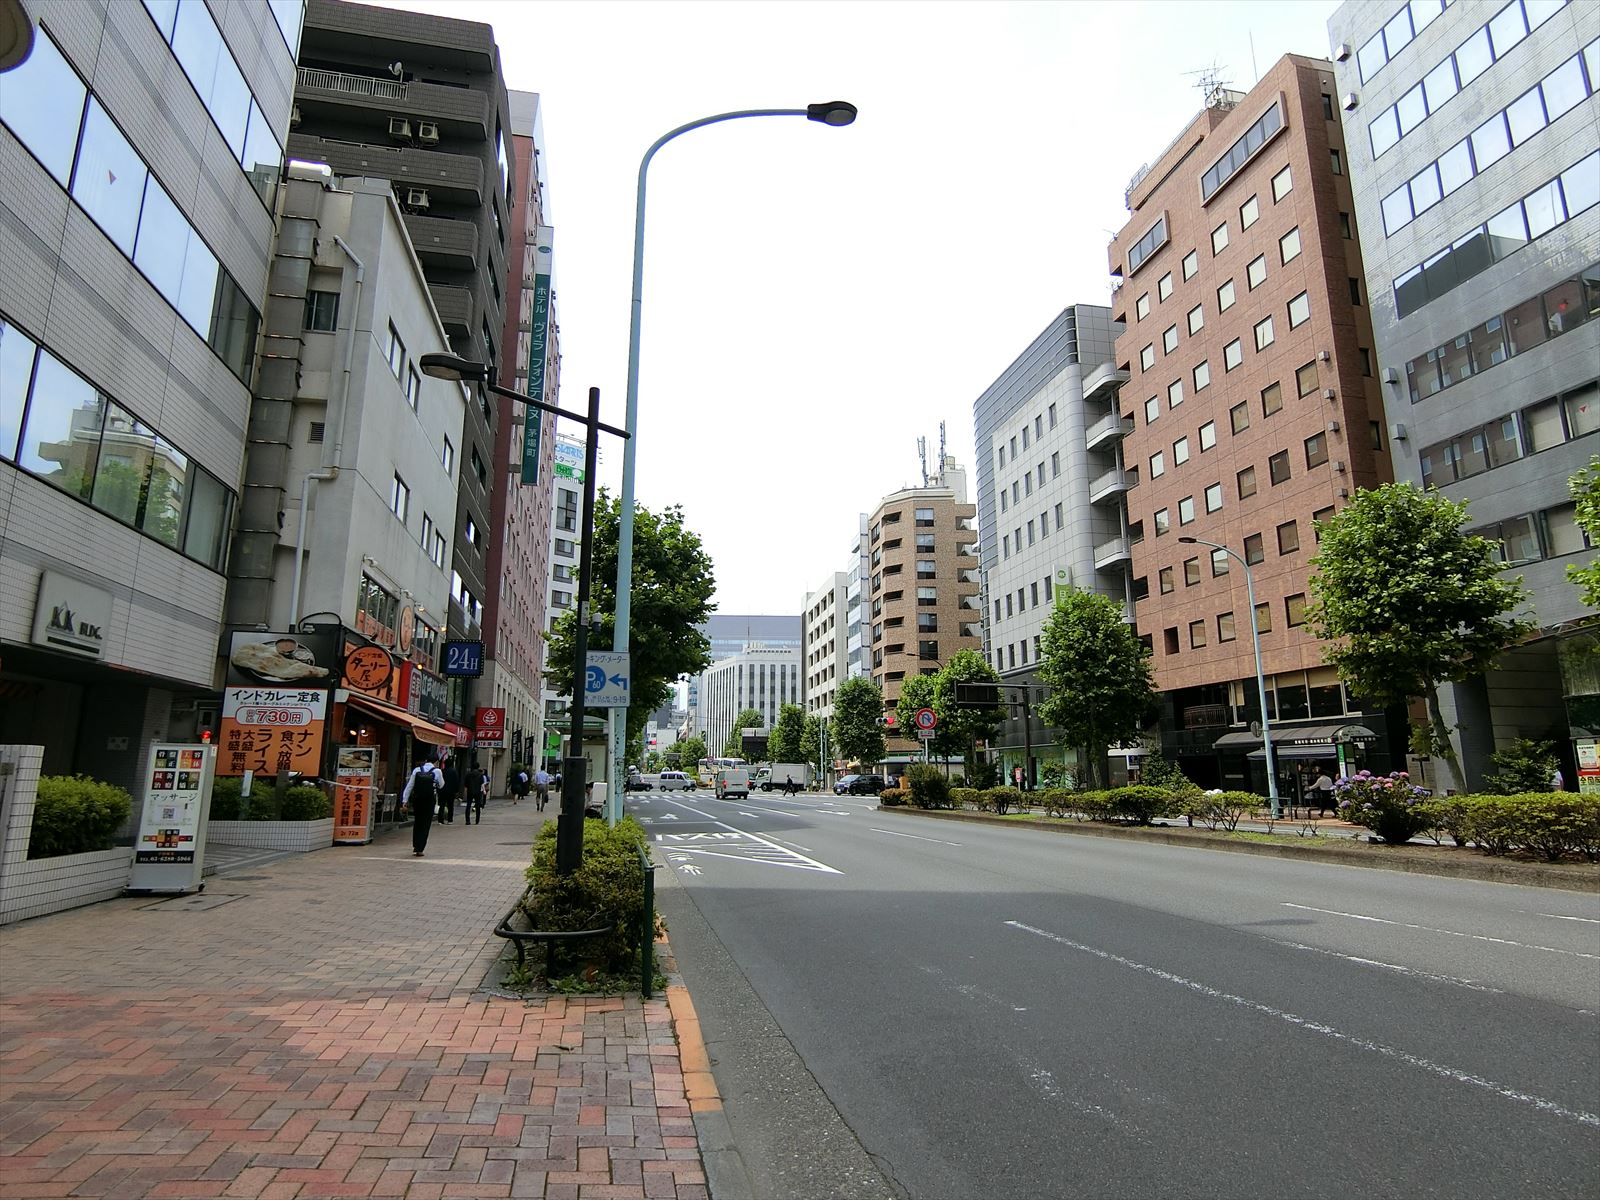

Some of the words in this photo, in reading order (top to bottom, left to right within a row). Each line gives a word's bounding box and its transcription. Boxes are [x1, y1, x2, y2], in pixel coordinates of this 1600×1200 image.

[535, 287, 546, 314] ホテル
[533, 321, 546, 350] ヴィラ
[529, 358, 543, 419] フォンテヌ
[448, 647, 479, 670] 24H
[586, 655, 628, 663] ーキング・メーター
[232, 689, 321, 703] インドカレー定食
[592, 681, 601, 689] 60
[256, 708, 303, 724] 730円
[254, 729, 273, 774] ライス
[295, 729, 314, 757] ナン
